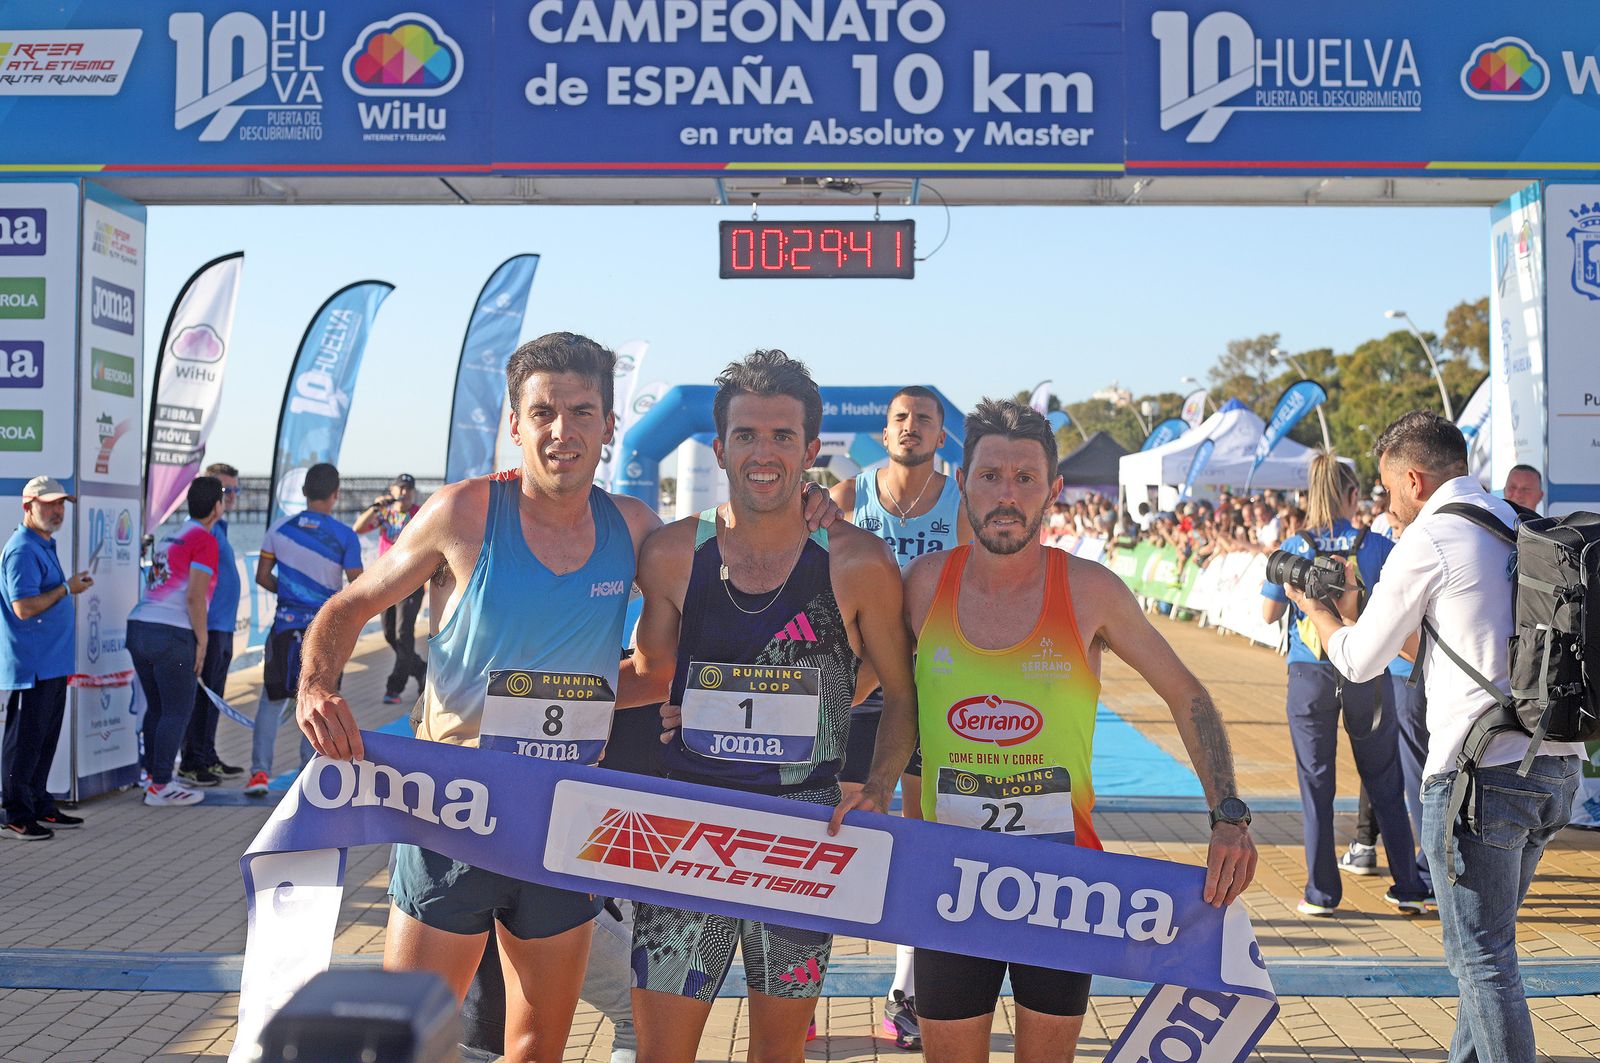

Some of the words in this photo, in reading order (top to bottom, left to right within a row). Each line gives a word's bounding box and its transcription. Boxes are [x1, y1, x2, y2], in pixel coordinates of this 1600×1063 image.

[528, 0, 945, 44] CAMPEONATO
[13, 43, 84, 60] RFEA
[6, 60, 115, 71] ATLETISMO
[1256, 38, 1421, 88] HUELVA
[0, 74, 44, 86] RUTA
[48, 74, 118, 86] RUNNING
[525, 63, 589, 106] de
[607, 55, 813, 106] ESPAÑA
[852, 52, 944, 115] 10
[973, 50, 1094, 114] km
[1256, 91, 1297, 107] PUERTA
[1301, 91, 1320, 107] DEL
[1323, 91, 1421, 107] DESCUBRIMIENTO
[267, 111, 303, 126] PUERTA
[304, 111, 323, 126] DEL
[358, 100, 447, 130] WiHu
[239, 126, 323, 141] DESCUBRIMIENTO
[362, 133, 398, 142] INTERNET
[680, 127, 718, 146] en
[729, 123, 793, 146] ruta
[803, 118, 944, 146] Absoluto
[953, 128, 975, 153] y
[984, 121, 1094, 146] Master
[732, 229, 903, 270] 00:29:41
[315, 309, 353, 377] HUELVA
[176, 365, 216, 383] WiHu
[160, 407, 195, 423] FIBRA
[823, 401, 838, 416] de
[590, 580, 624, 598] HOKA
[732, 668, 802, 680] RUNNING
[1022, 661, 1072, 672] SERRANO
[543, 675, 603, 687] RUNNING
[750, 682, 790, 692] LOOP
[558, 689, 593, 699] LOOP
[542, 705, 564, 737] 8
[738, 698, 754, 729] 1
[956, 708, 1035, 731] Serrano
[710, 734, 784, 756] Joma
[949, 752, 973, 764] COME
[976, 753, 1000, 765] BIEN
[1003, 754, 1009, 765] Y
[1012, 754, 1044, 765] CORRE
[985, 769, 1053, 785] RUNNING
[1002, 785, 1043, 797] LOOP
[980, 802, 1026, 832] 22
[681, 822, 859, 875] RFEA
[667, 859, 837, 899] ATLETISMO
[936, 857, 1180, 945] Joma
